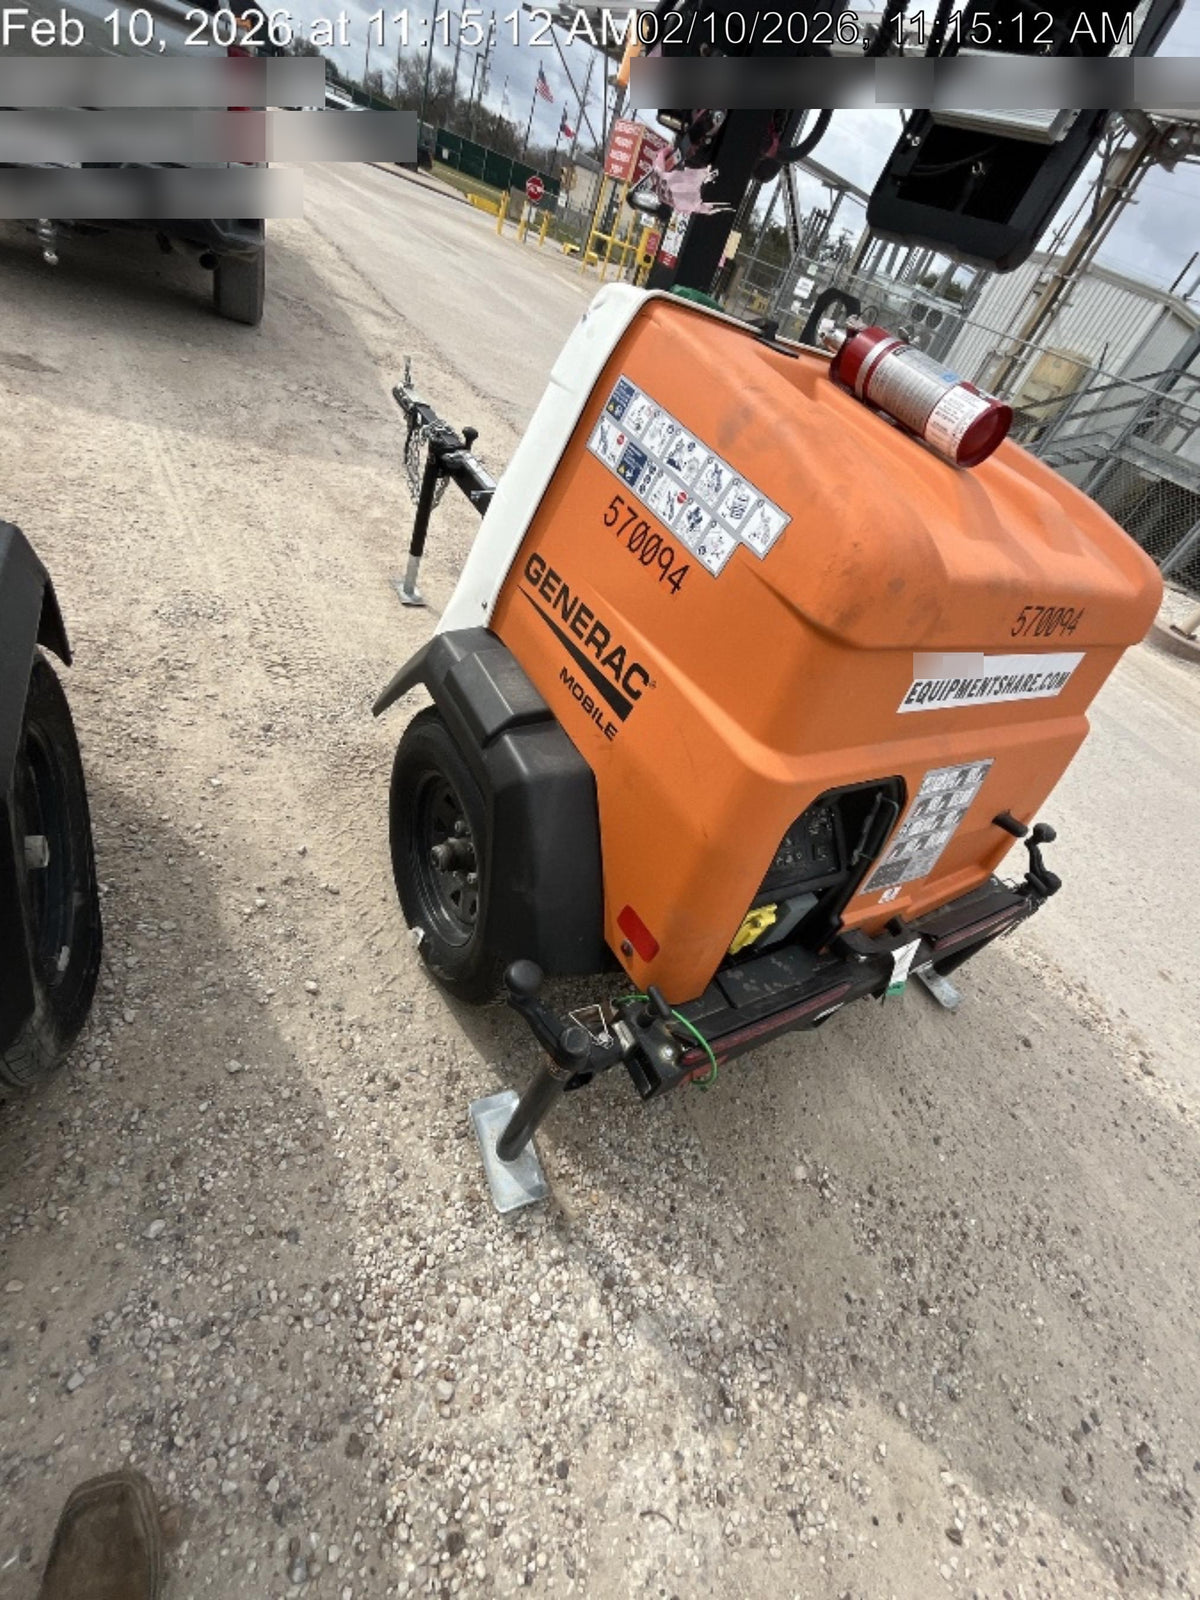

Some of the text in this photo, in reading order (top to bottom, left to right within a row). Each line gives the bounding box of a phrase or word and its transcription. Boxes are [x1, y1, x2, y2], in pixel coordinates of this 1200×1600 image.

[603, 495, 690, 595] 570094
[1010, 605, 1085, 638] 570094
[559, 666, 618, 741] MOBILE
[904, 671, 1071, 705] EQUIPMENTSHARE.COM
